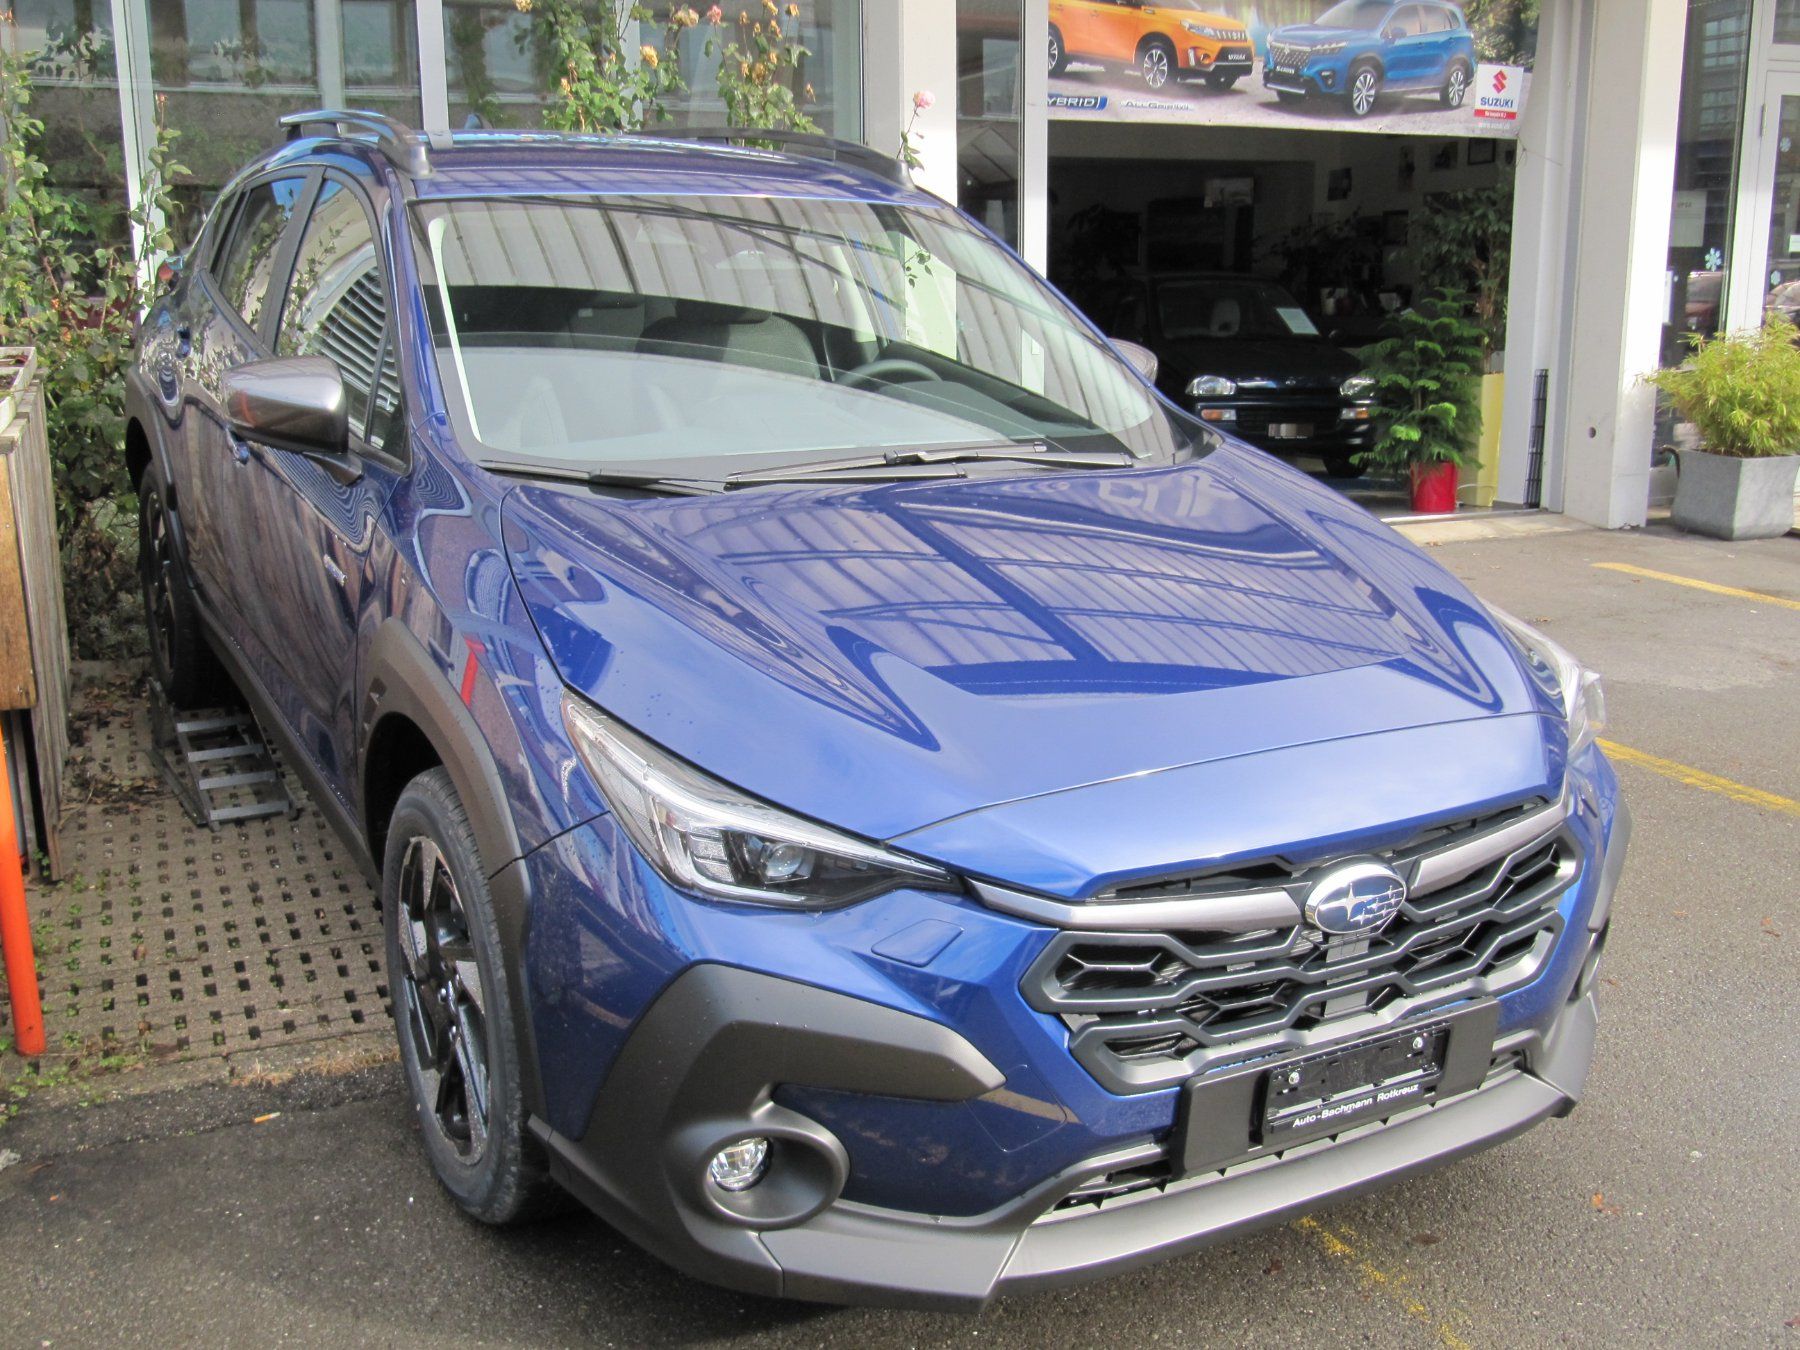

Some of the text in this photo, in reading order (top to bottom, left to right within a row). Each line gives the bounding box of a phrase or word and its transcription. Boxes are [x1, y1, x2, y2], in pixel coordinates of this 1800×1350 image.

[1047, 97, 1095, 107] YBRID
[1480, 97, 1514, 109] SUZUKI
[1292, 1083, 1419, 1128] Auto-Bachmann Rotkreuz
